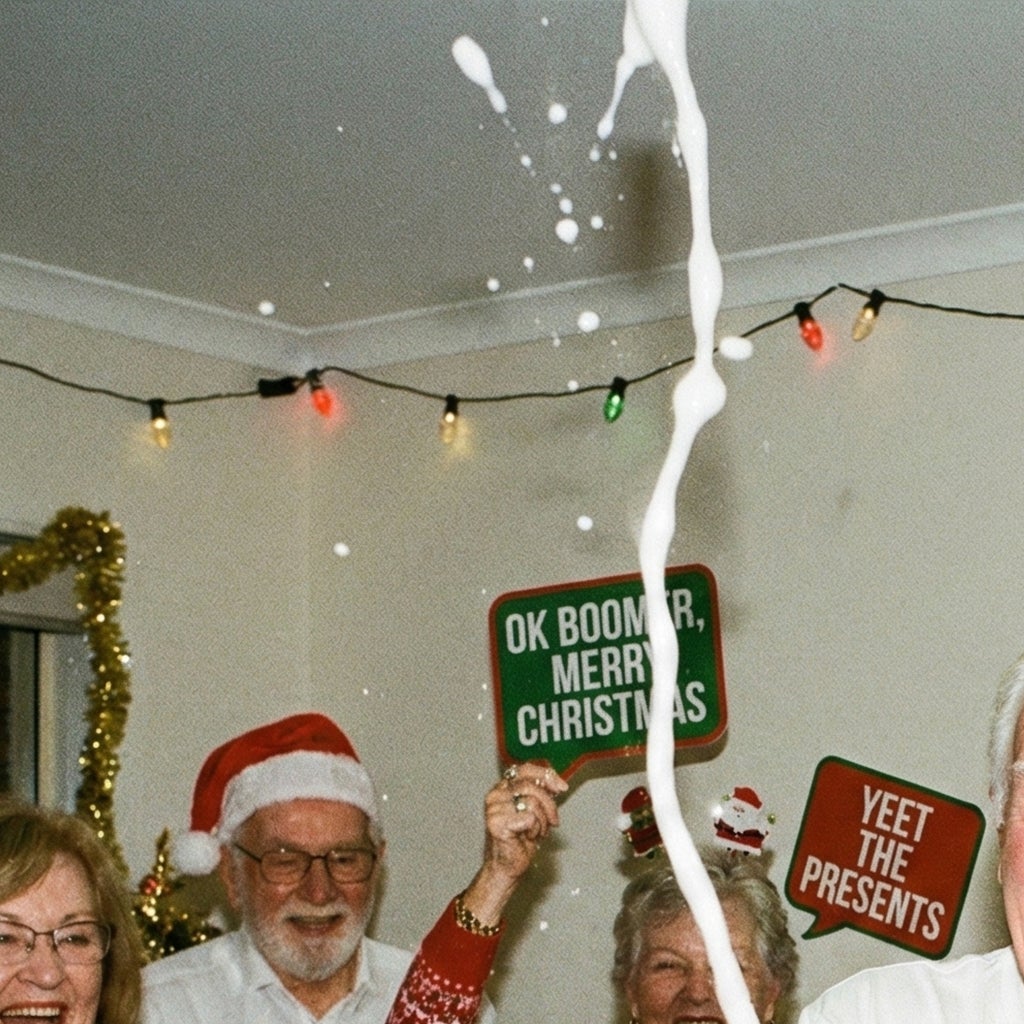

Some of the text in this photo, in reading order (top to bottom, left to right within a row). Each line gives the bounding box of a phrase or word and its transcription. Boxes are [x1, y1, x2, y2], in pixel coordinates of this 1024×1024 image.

[505, 587, 706, 655] OK BOOMR,
[863, 784, 935, 843] YEET
[856, 828, 915, 884] THE
[799, 855, 946, 942] PRESENTS
